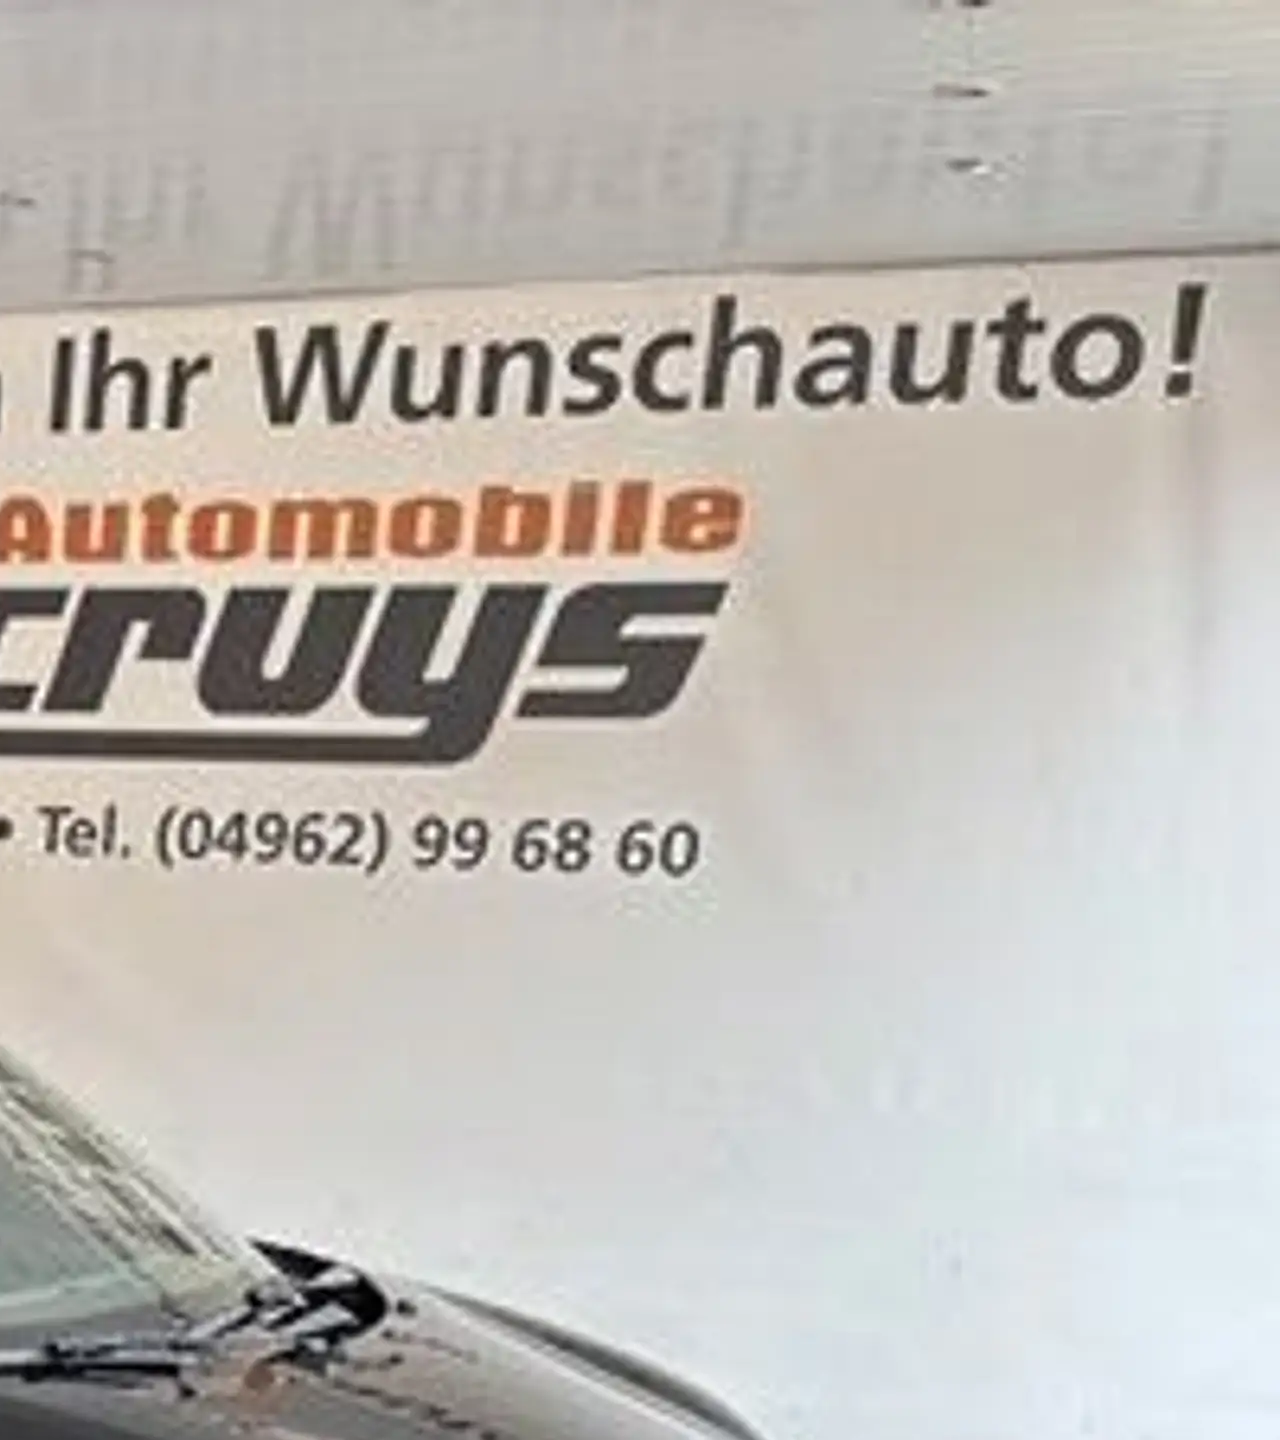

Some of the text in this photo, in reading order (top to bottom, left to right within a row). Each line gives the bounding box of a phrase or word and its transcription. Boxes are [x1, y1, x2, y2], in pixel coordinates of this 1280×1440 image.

[50, 328, 211, 432] Ihr
[255, 284, 1206, 425] Wunschauto!
[39, 804, 130, 859] Tel.
[156, 807, 389, 874] (04962)
[413, 815, 490, 870] 99
[512, 818, 592, 873] 68
[616, 820, 700, 878] 60
